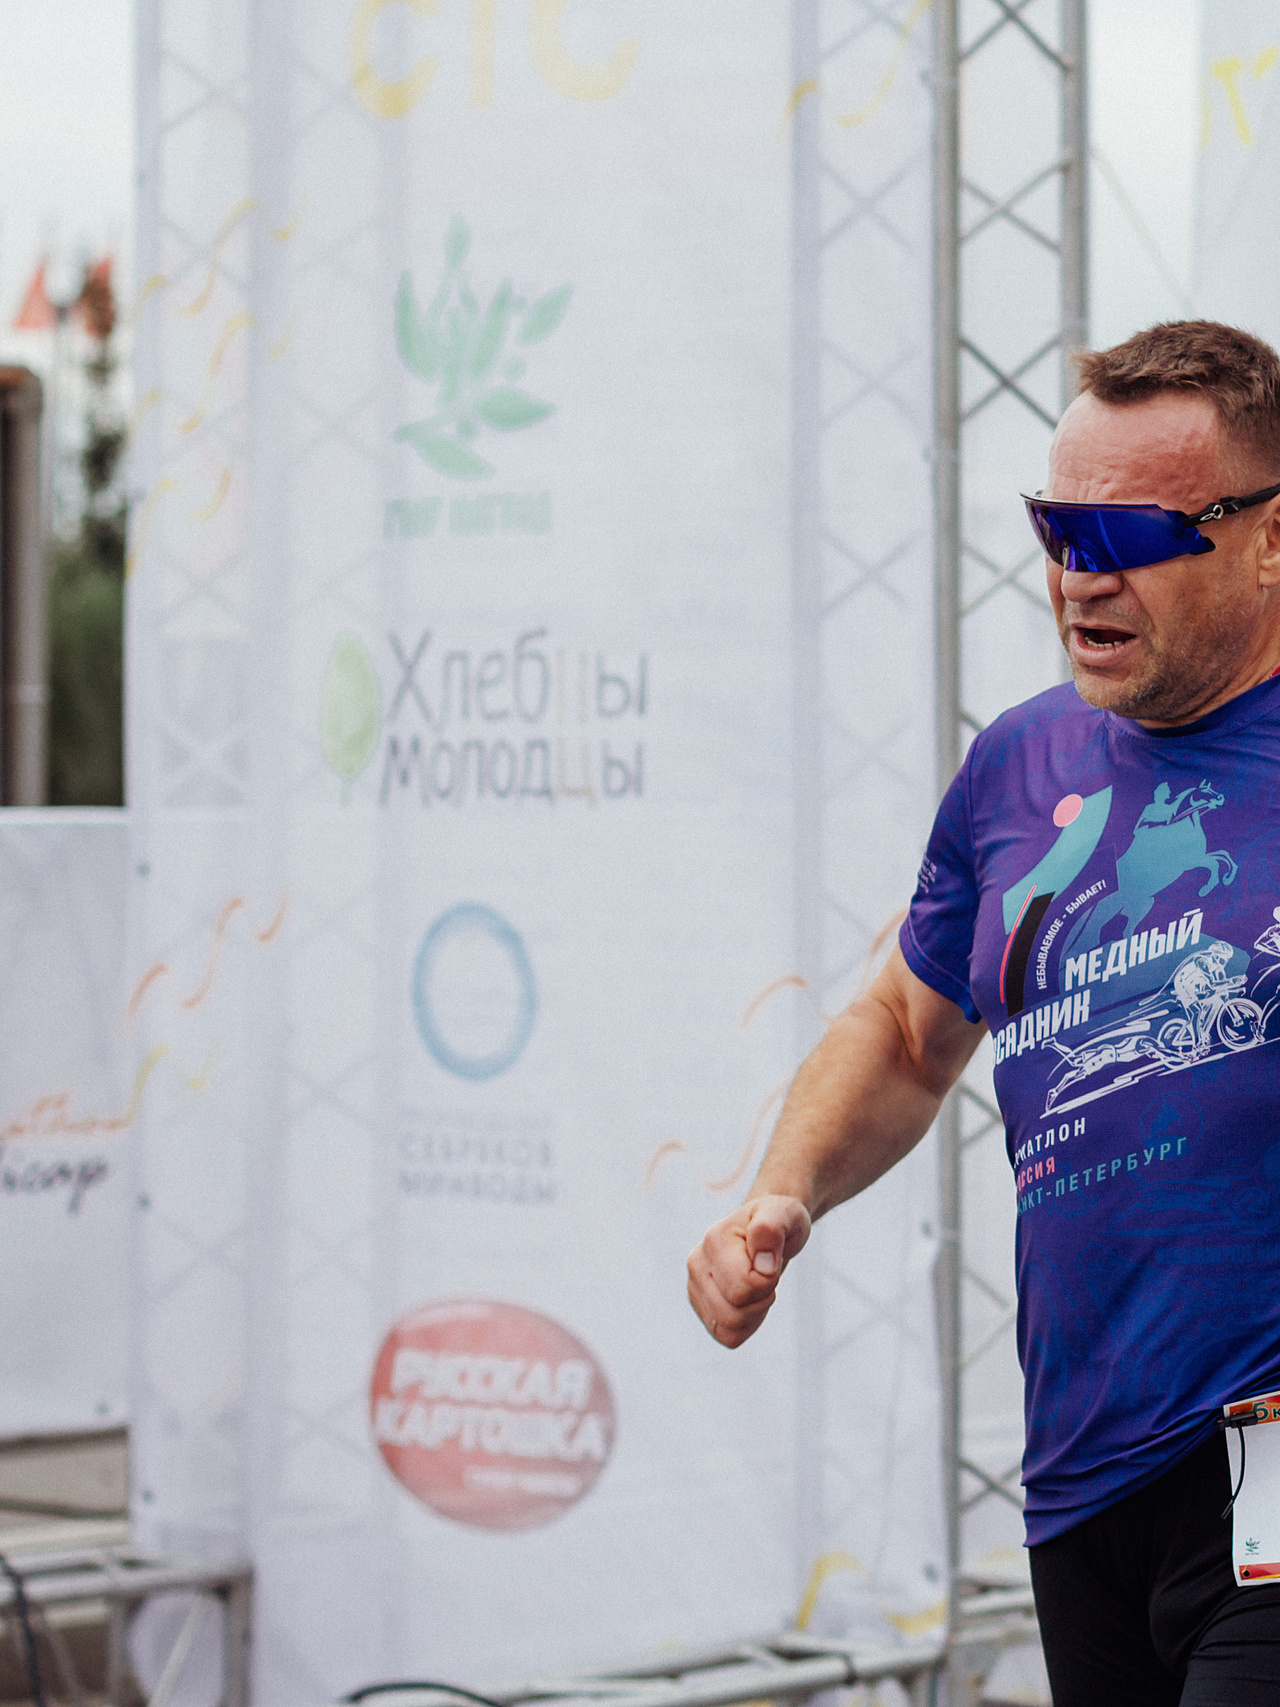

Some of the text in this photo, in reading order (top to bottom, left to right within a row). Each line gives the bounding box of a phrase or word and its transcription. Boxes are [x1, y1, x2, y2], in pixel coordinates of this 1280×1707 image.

[386, 627, 649, 731] Хлебцы
[1036, 918, 1064, 990] НЕБЫВАЕМОЕ
[1065, 879, 1107, 914] БЫВАЕТ!
[1065, 908, 1203, 992] МЕДНЫЙ
[394, 1350, 591, 1407] РУССКАЯ
[376, 1398, 604, 1461] КАРТОШКА
